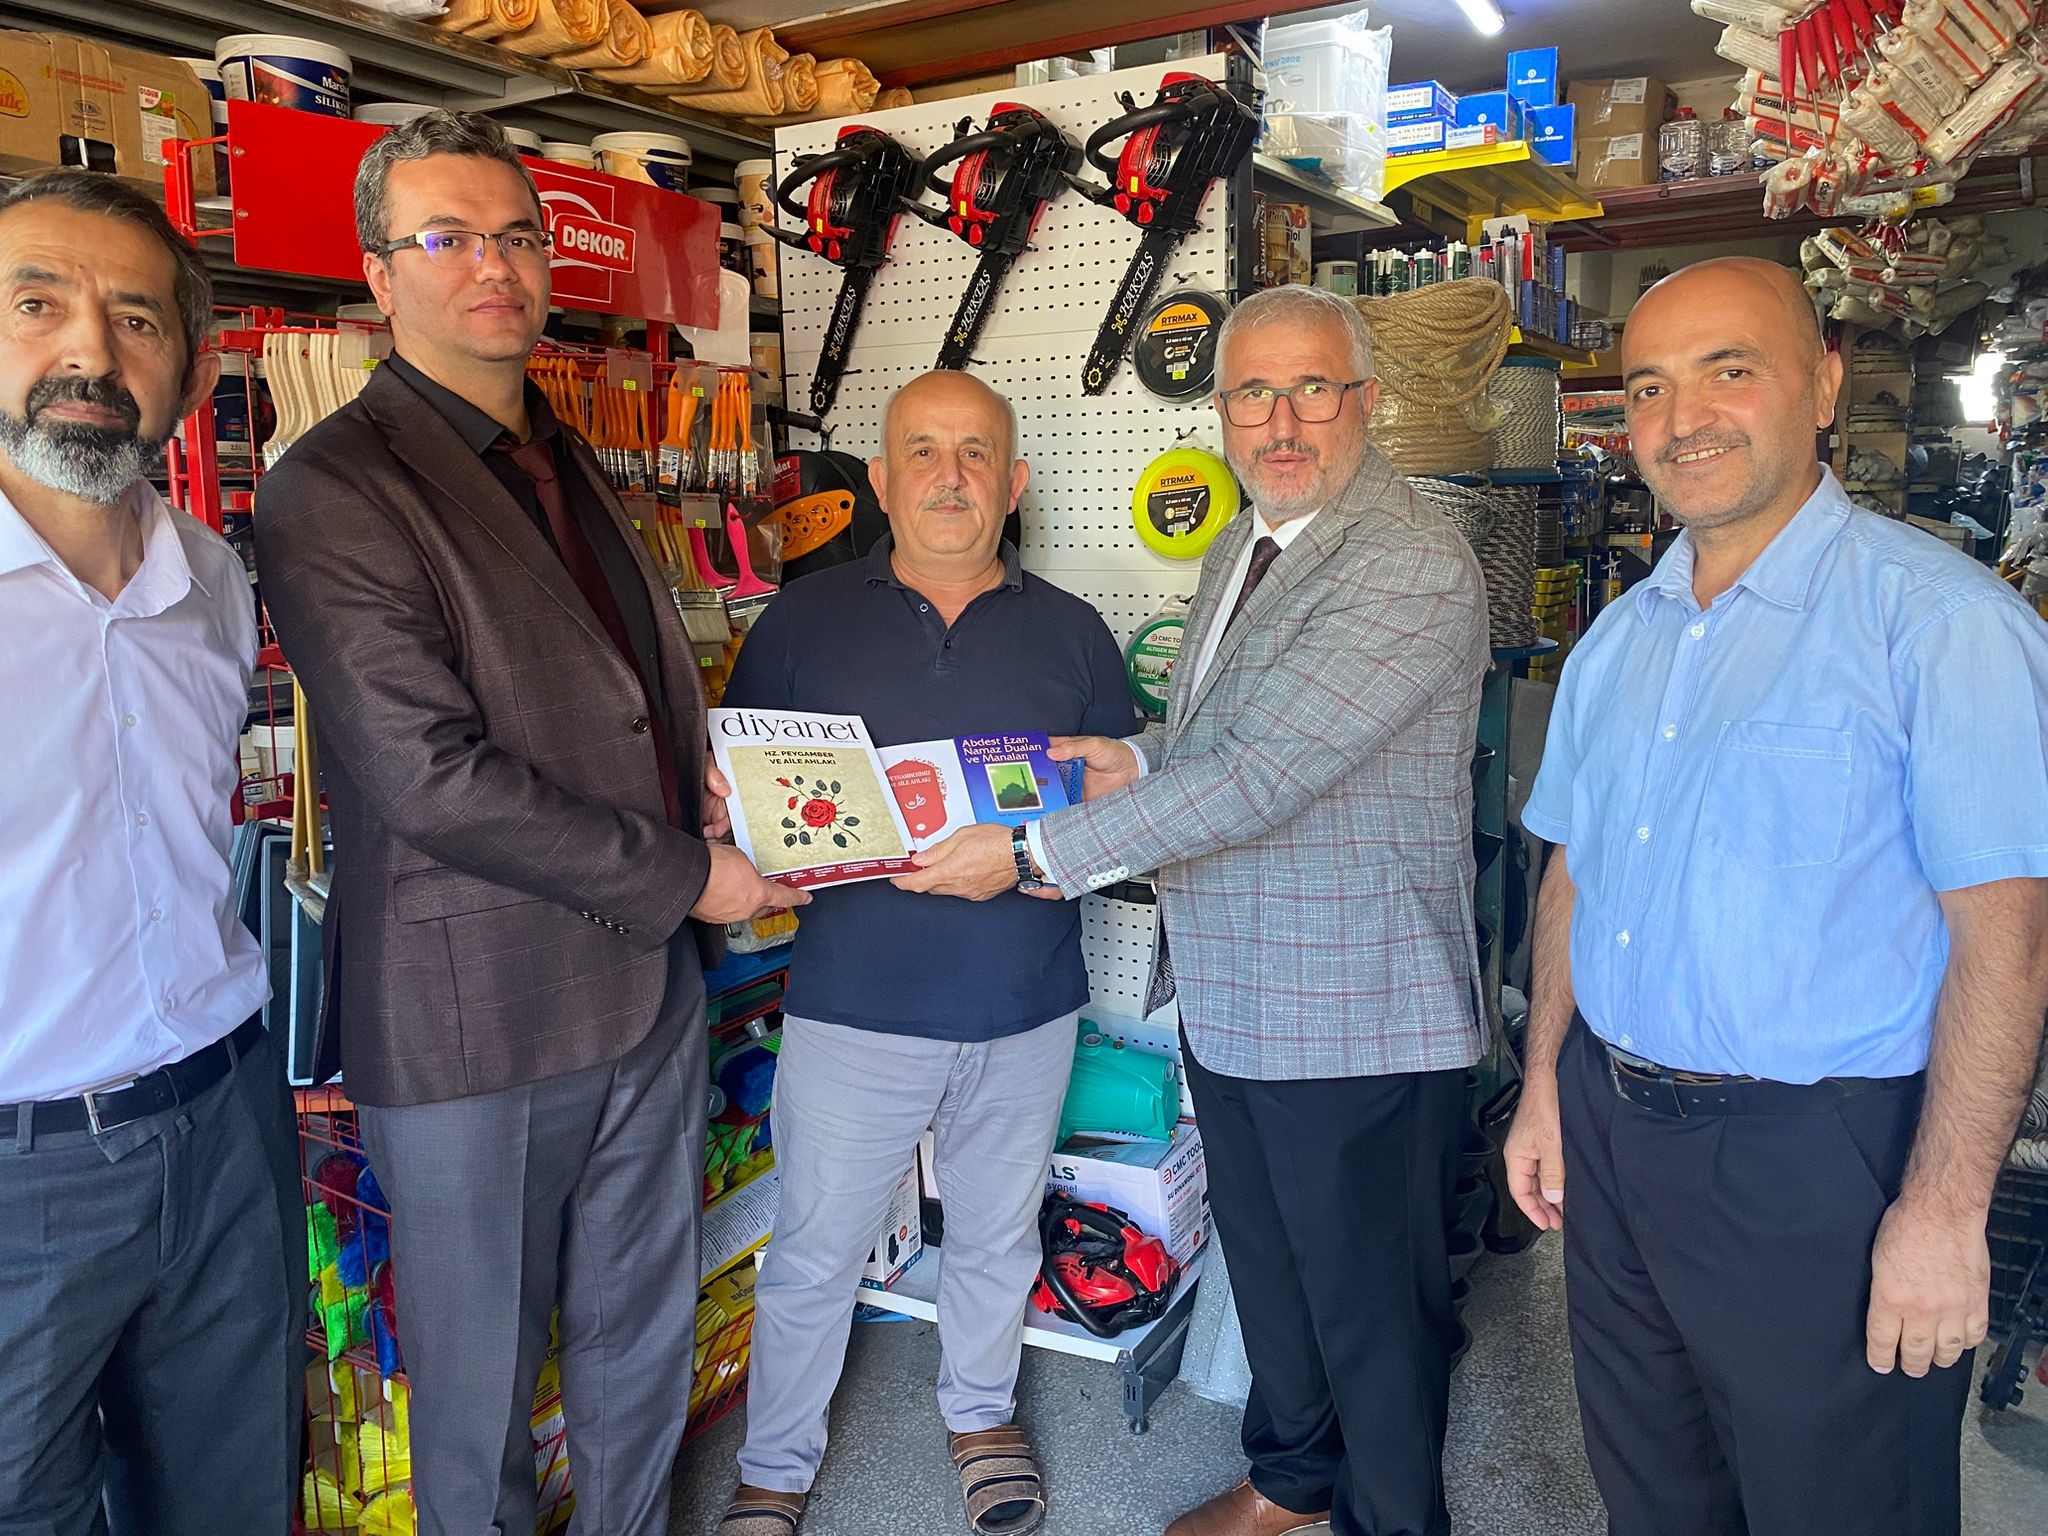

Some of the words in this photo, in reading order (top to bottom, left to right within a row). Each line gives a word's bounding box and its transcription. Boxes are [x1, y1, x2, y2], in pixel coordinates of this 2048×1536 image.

[1161, 312, 1198, 325] RTRMAX
[774, 459, 791, 476] lder
[1160, 474, 1195, 487] RTRMAX
[1158, 635, 1172, 643] CMC
[720, 711, 860, 742] diyanet
[962, 737, 1001, 748] Abdest
[1002, 736, 1029, 745] Ezan
[781, 750, 835, 758] PEYGAMBER
[963, 746, 1002, 756] Namaz
[783, 757, 804, 765] AİLE
[804, 758, 837, 766] AHLAKI
[965, 756, 980, 764] ve
[1172, 1155, 1187, 1175] CMC
[1187, 1140, 1203, 1161] TOOL
[1050, 1163, 1076, 1181] LS
[1047, 1182, 1078, 1193] syonel
